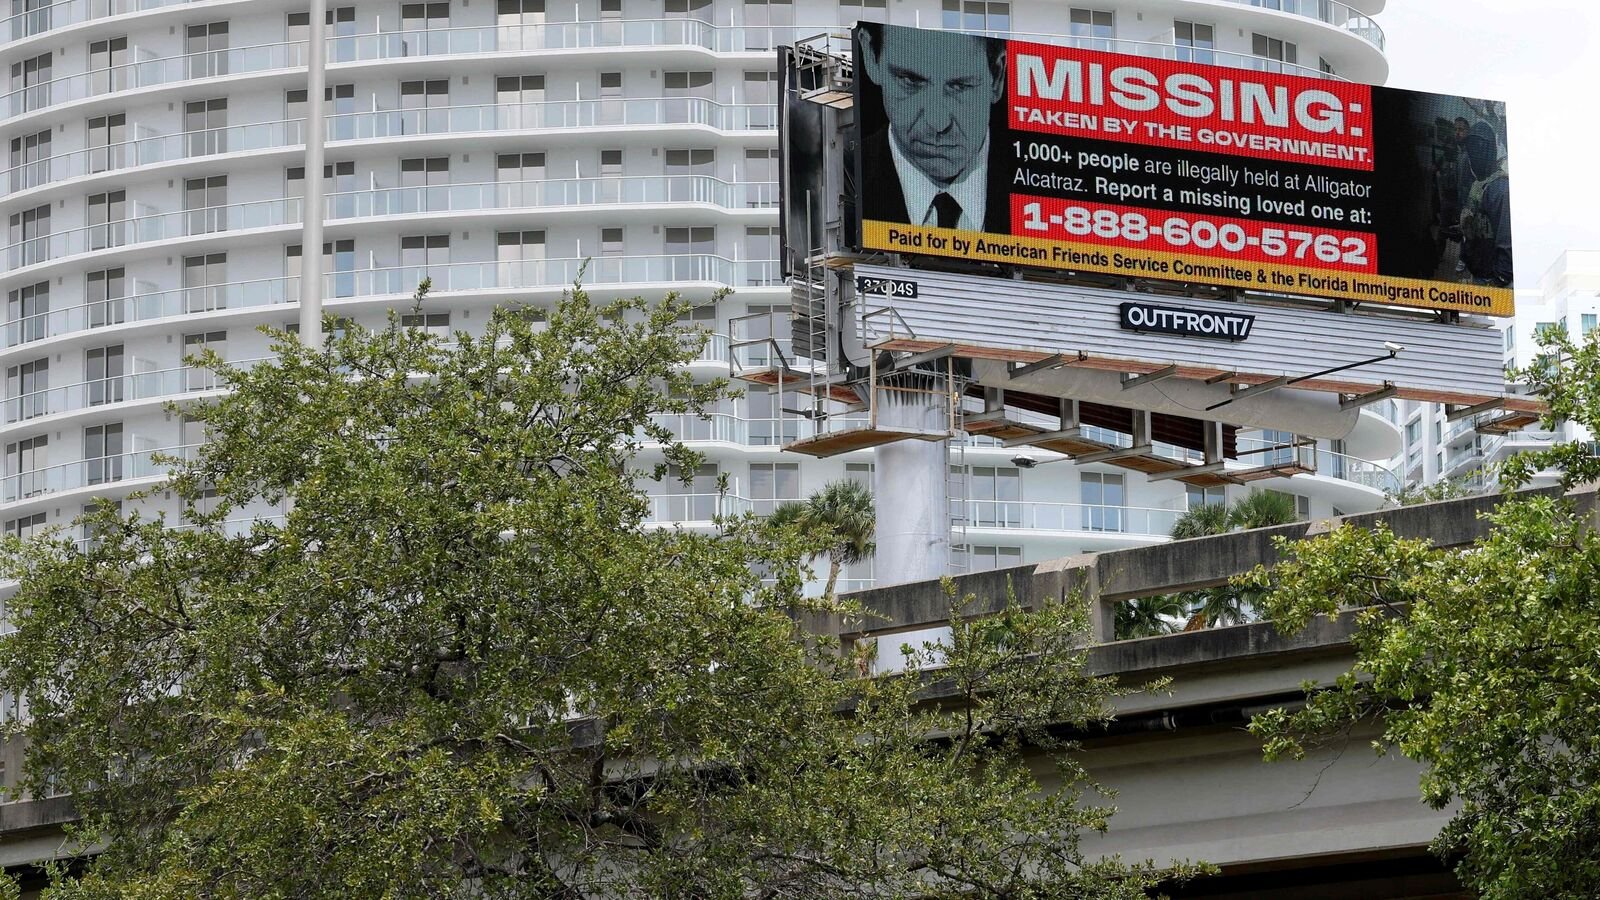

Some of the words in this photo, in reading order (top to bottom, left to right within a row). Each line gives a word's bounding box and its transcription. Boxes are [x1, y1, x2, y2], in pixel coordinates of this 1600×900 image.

[1016, 54, 1363, 137] MISSING:
[1014, 106, 1097, 130] TAKEN
[1103, 117, 1138, 135] BY
[1144, 121, 1192, 142] THE
[1197, 128, 1372, 163] GOVERNMENT.
[1013, 142, 1072, 164] 1,000+
[1078, 152, 1139, 173] people
[1144, 159, 1172, 175] are
[1177, 159, 1239, 186] illegally
[1244, 167, 1279, 189] held
[1284, 174, 1300, 191] at
[1304, 176, 1372, 199] Alligator
[1013, 168, 1088, 193] Alcatraz.
[1095, 176, 1157, 202] Report
[1163, 188, 1173, 202] a
[1180, 188, 1251, 215] missing
[1257, 195, 1305, 217] loved
[1311, 205, 1344, 222] one
[1350, 208, 1372, 224] at:
[1023, 202, 1368, 265] 1-888-600-5762
[889, 229, 922, 248] Paid
[926, 233, 947, 251] for
[952, 237, 970, 255] by
[976, 238, 1048, 261] American
[1052, 247, 1108, 267] Friends
[1113, 253, 1169, 274] Service
[1173, 259, 1252, 282] Committee
[1257, 268, 1267, 283] &
[1271, 270, 1294, 287] the
[1299, 273, 1348, 292] Florida
[1352, 278, 1424, 301] Immigrant
[1428, 287, 1491, 308] Coalition
